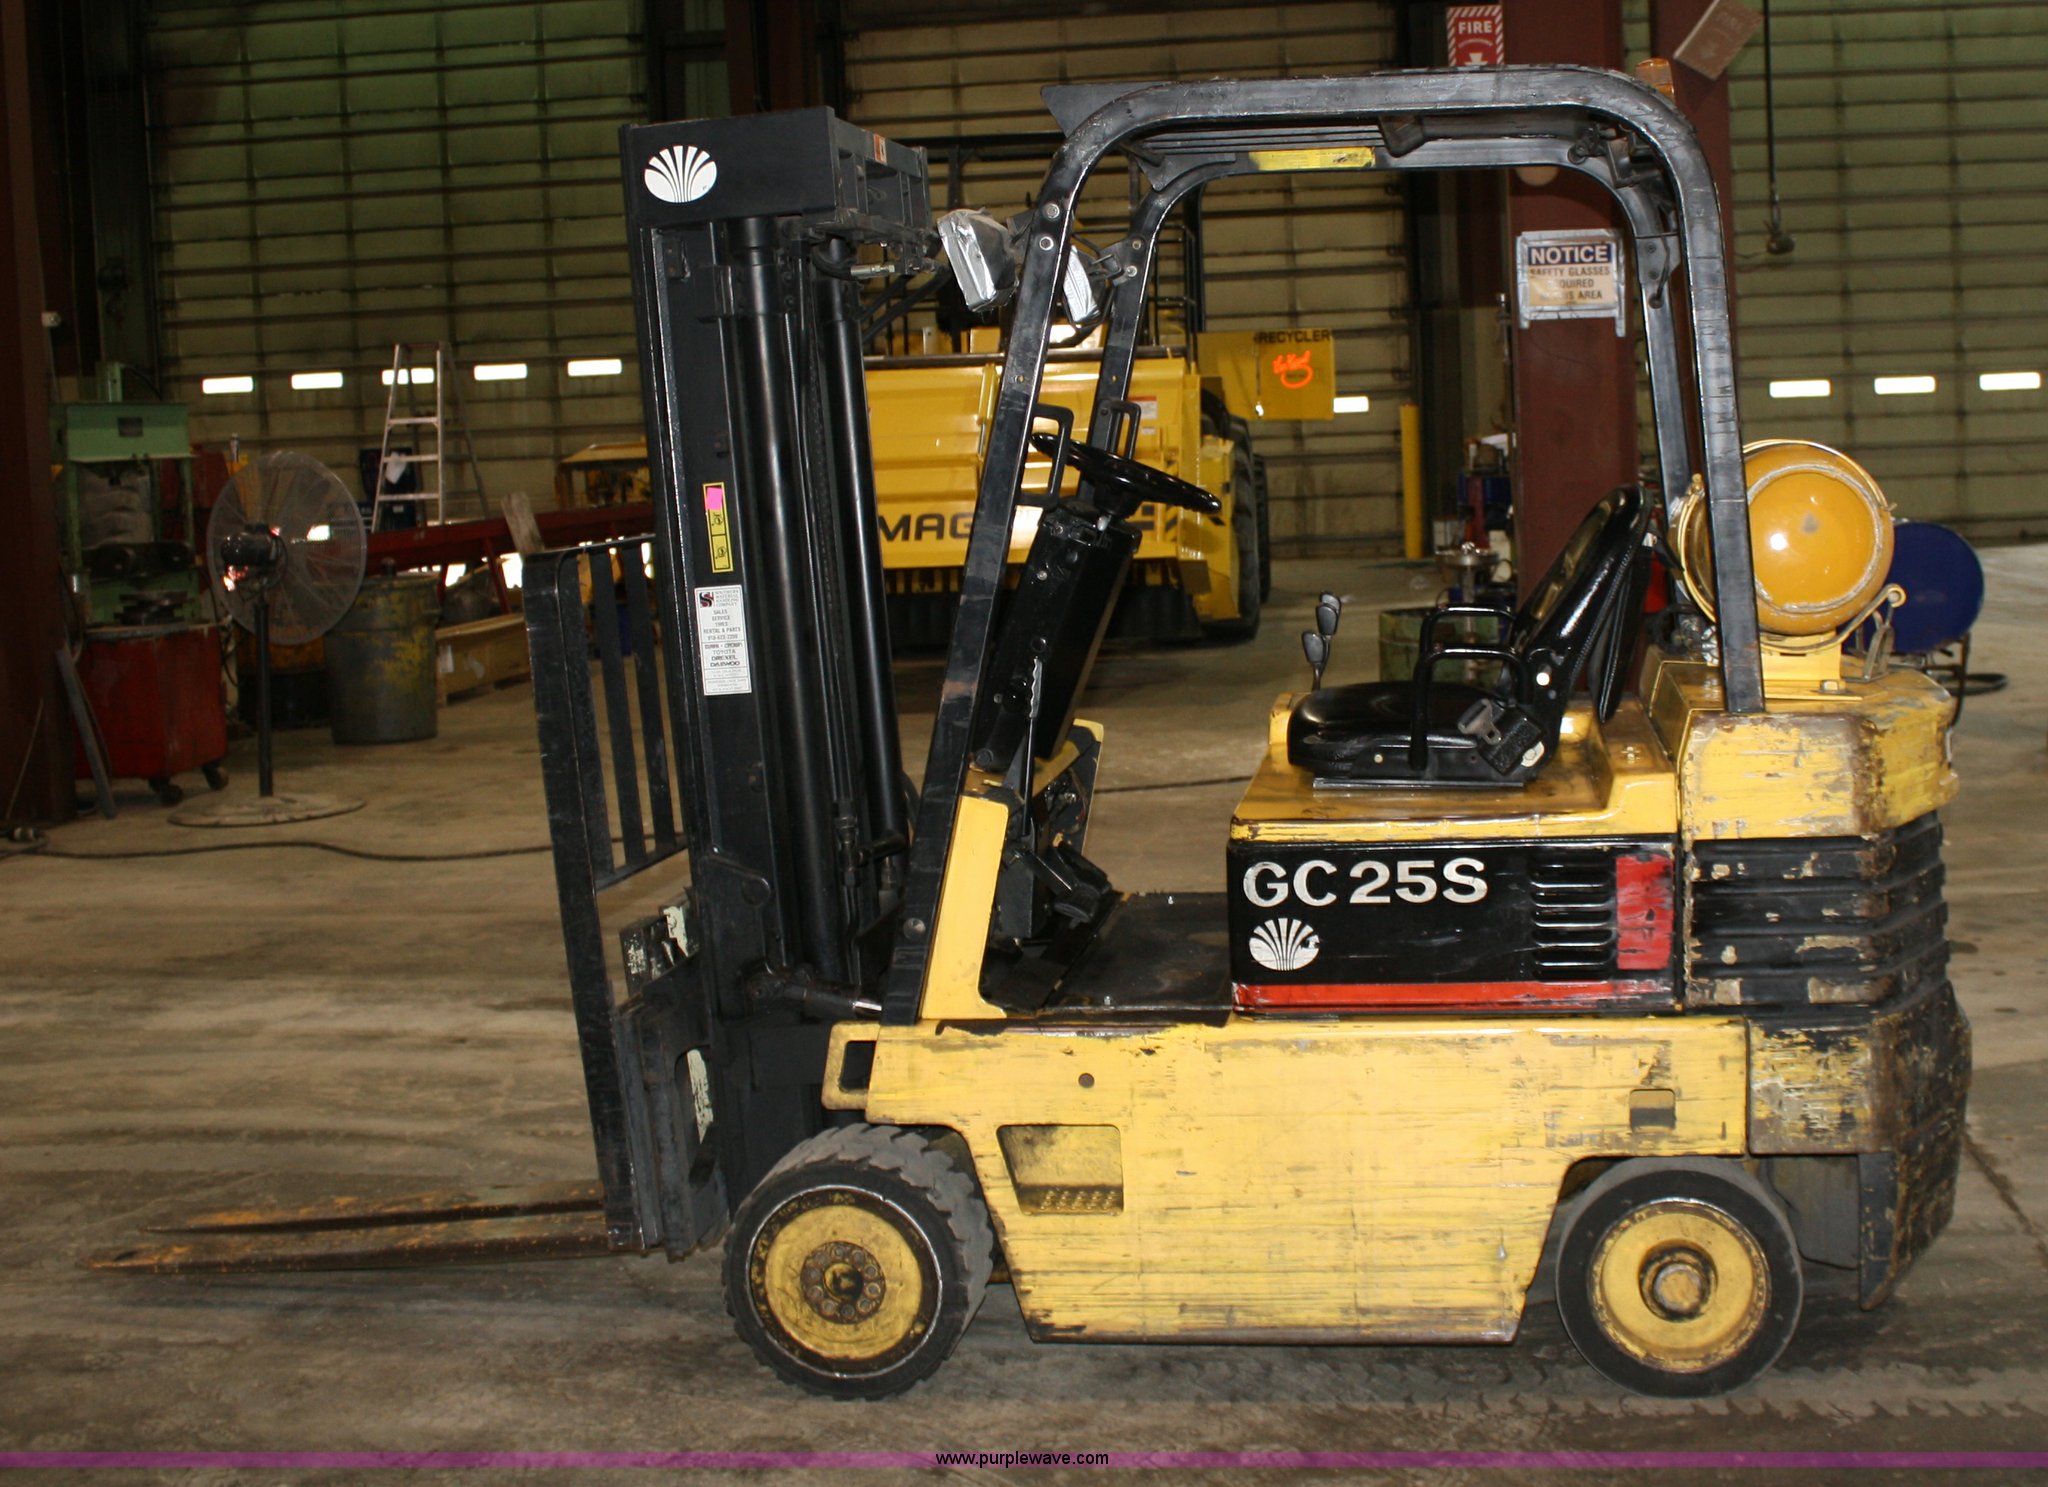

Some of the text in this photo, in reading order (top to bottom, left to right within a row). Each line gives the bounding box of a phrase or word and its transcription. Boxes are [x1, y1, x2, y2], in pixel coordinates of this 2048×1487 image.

[1458, 20, 1493, 34] FIRE
[1530, 245, 1608, 264] NOTICE
[1568, 266, 1610, 276] GLASSES
[1578, 290, 1602, 299] AREA
[1259, 329, 1331, 343] RECYCLER
